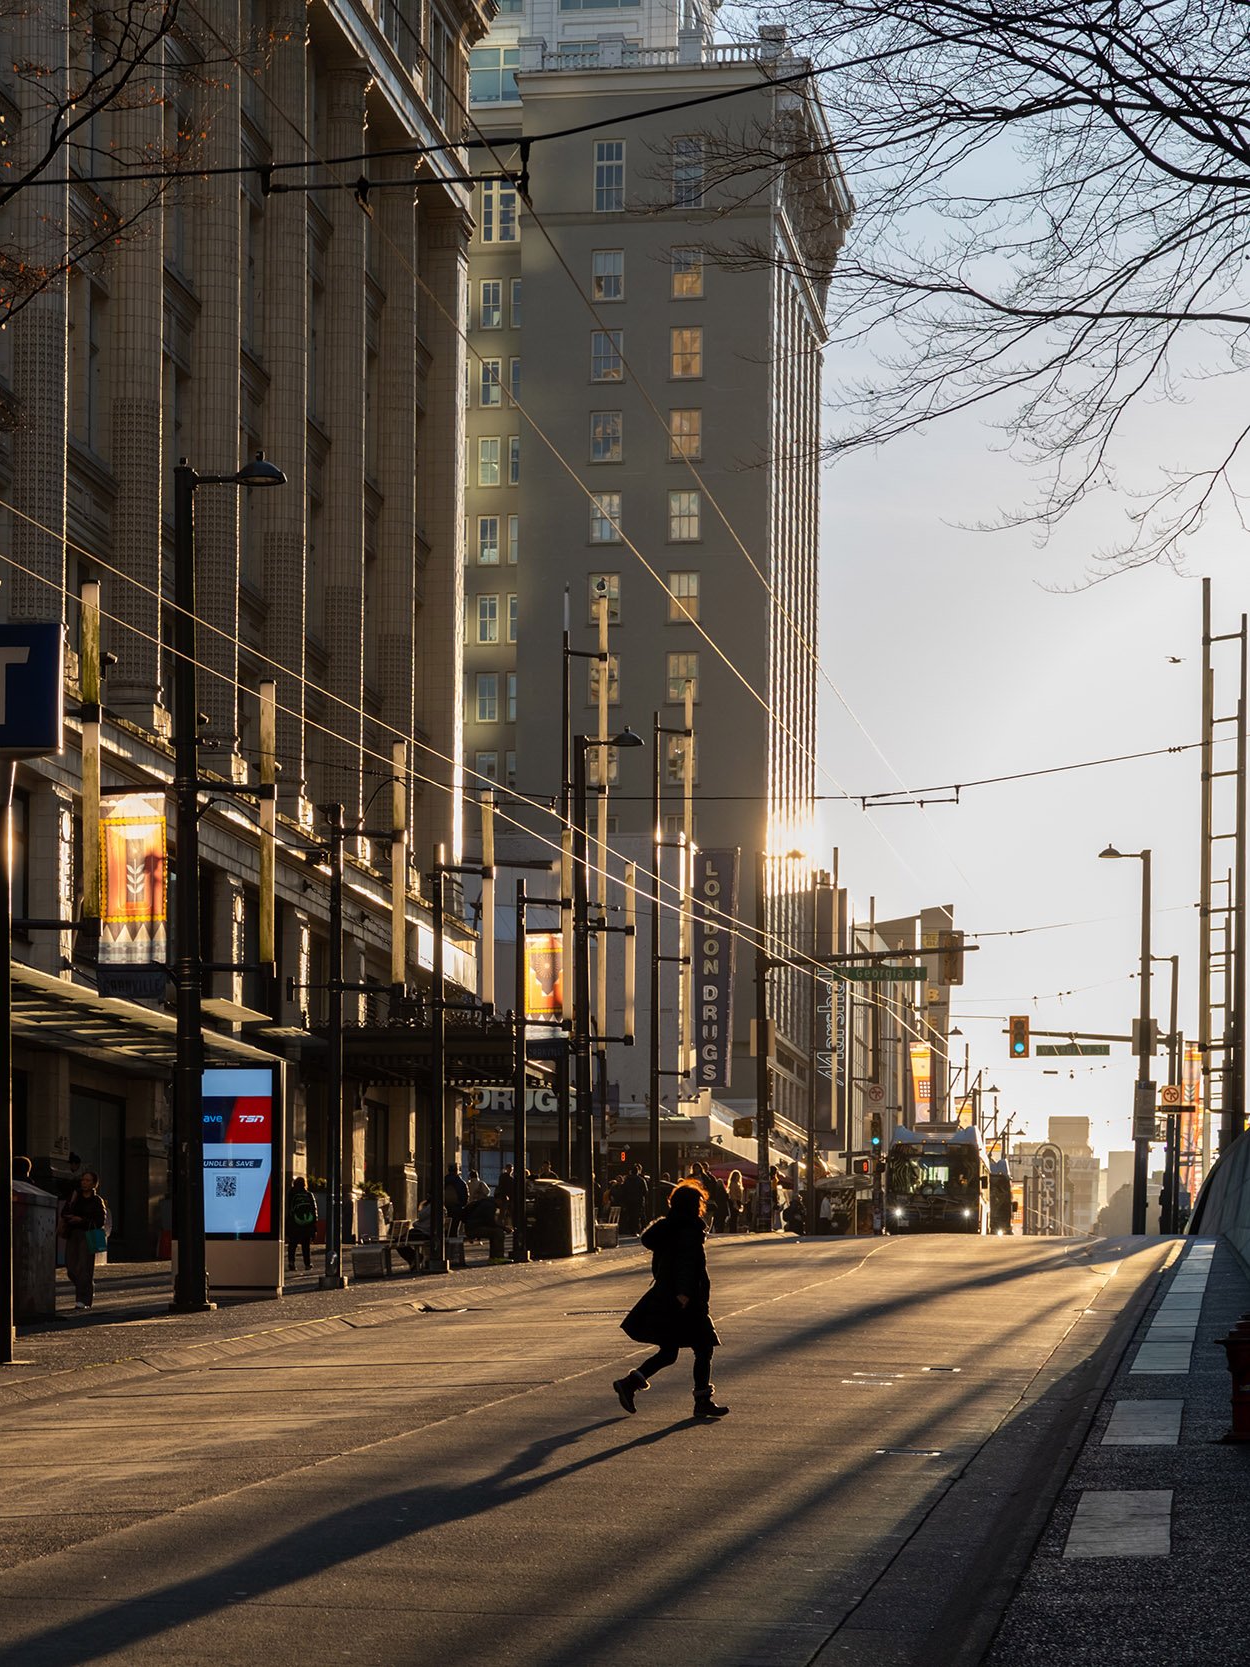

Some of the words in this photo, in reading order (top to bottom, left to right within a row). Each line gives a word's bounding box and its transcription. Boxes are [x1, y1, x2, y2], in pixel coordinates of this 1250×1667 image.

[702, 860, 720, 975] LONDON
[840, 968, 850, 978] W
[855, 968, 904, 979] Georgia
[911, 968, 921, 978] St
[701, 984, 719, 1081] DRUGS
[816, 961, 845, 1087] Marshall
[203, 1114, 223, 1123] ave
